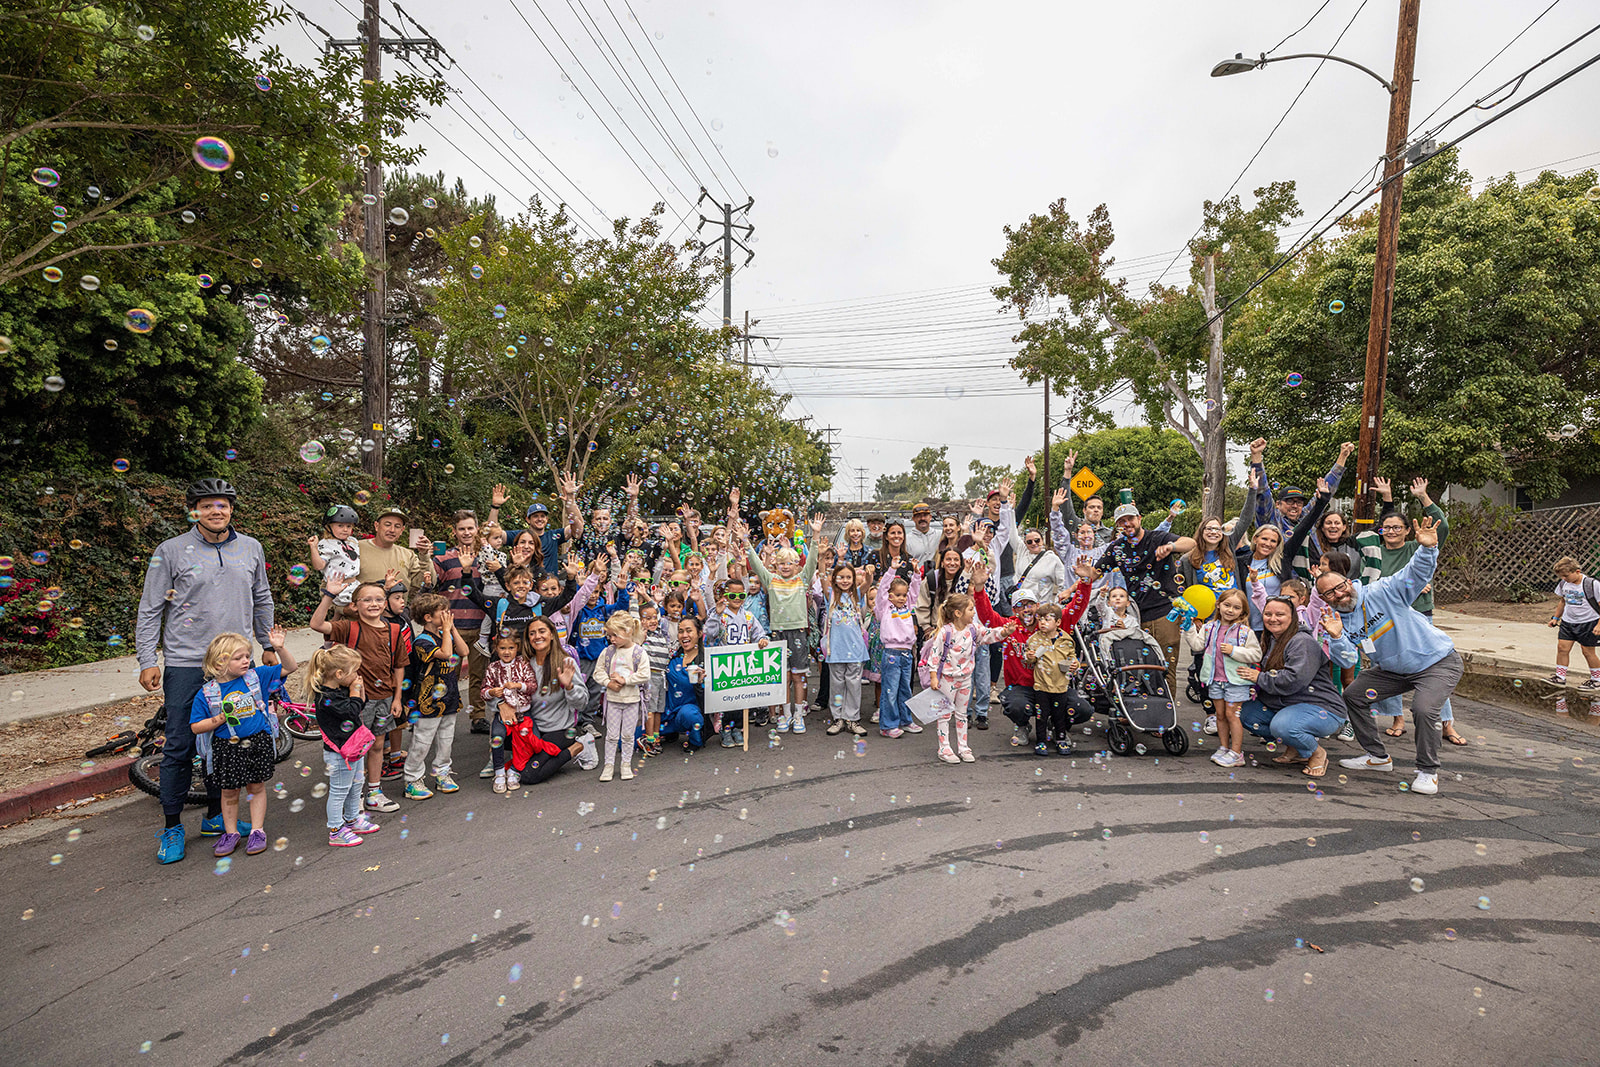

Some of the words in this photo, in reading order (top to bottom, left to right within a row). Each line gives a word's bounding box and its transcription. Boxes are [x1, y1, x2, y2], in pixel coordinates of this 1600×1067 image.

[1076, 480, 1094, 488] END
[712, 651, 780, 679] WALK
[716, 681, 728, 689] TO
[730, 676, 764, 687] SCHOOL
[765, 674, 780, 682] DAY
[722, 694, 734, 702] City
[741, 692, 757, 700] Costa
